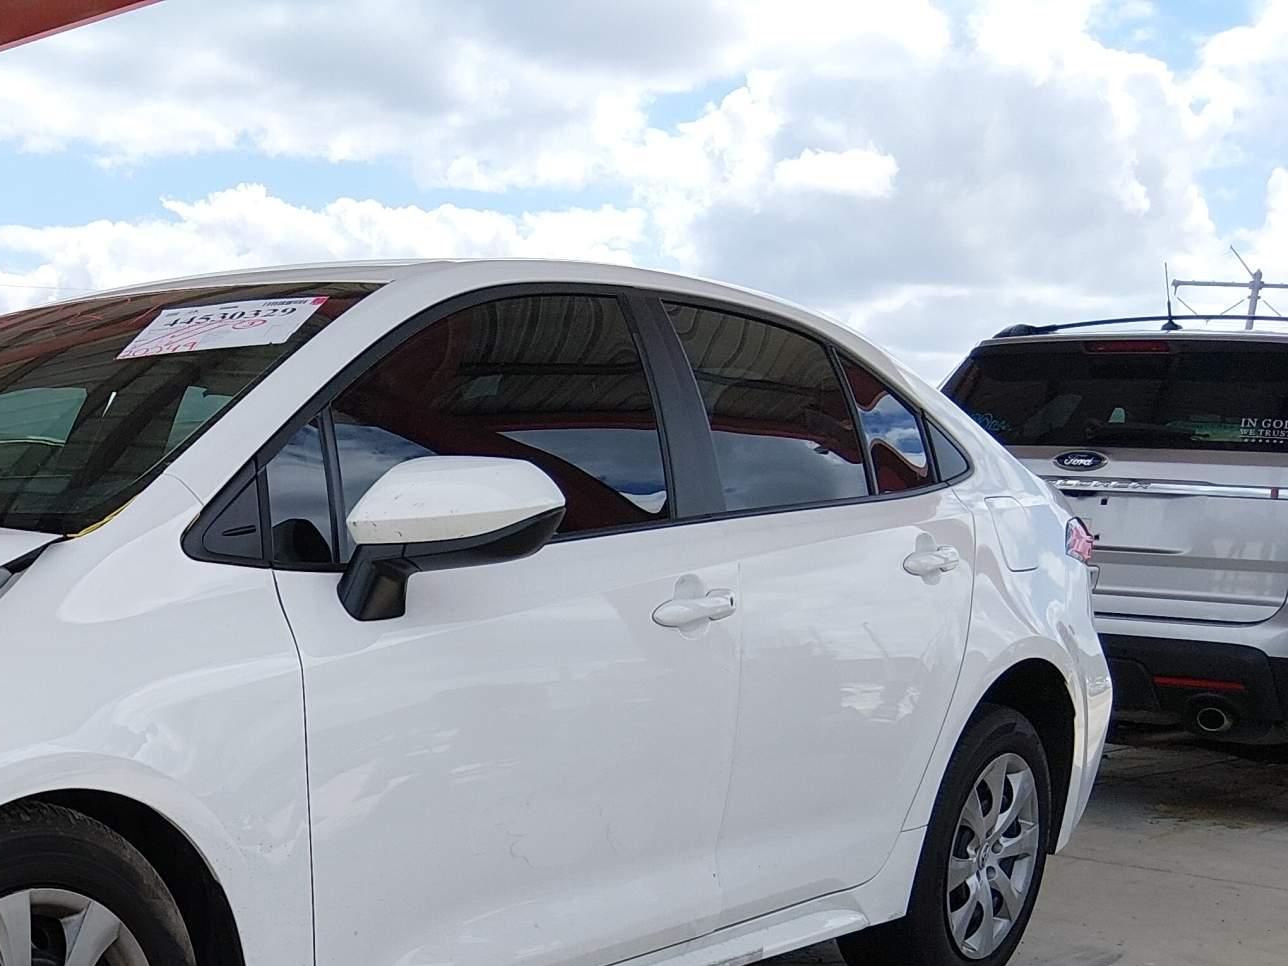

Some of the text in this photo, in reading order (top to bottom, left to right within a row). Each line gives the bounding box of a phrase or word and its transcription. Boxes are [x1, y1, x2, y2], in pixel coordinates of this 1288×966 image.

[164, 307, 297, 327] 44530329
[1240, 418, 1258, 427] IN
[1064, 454, 1094, 466] Ford
